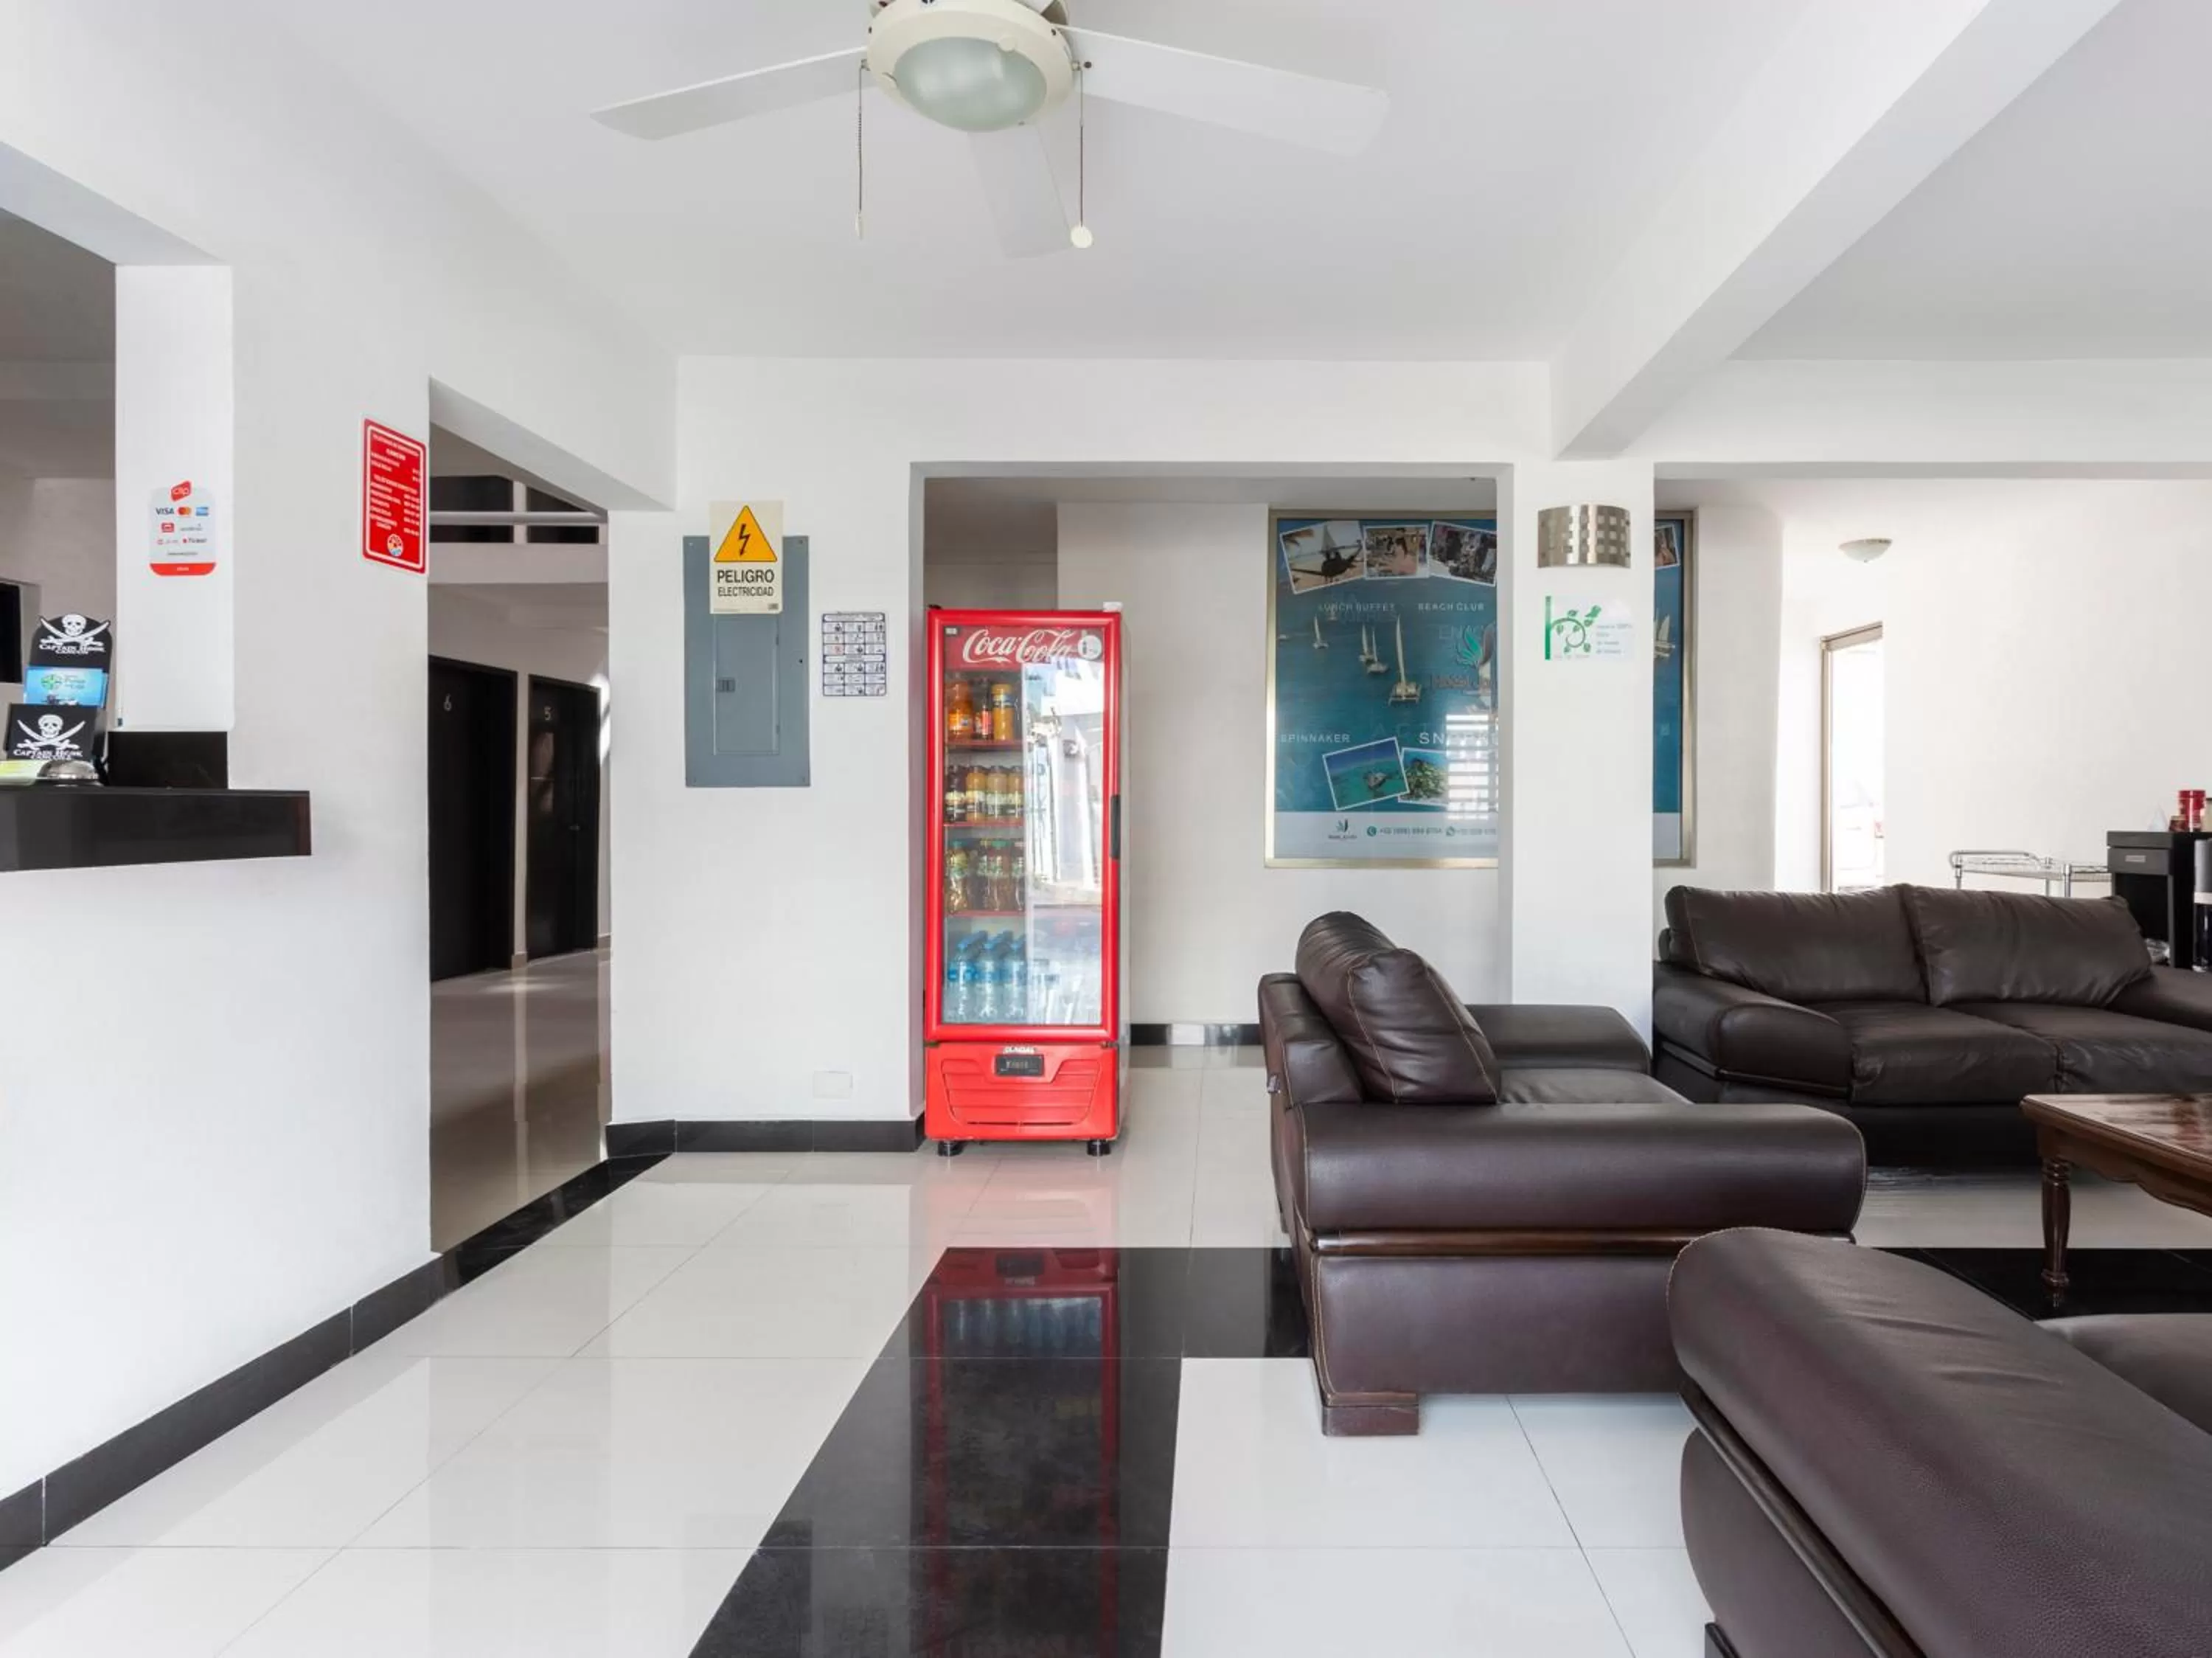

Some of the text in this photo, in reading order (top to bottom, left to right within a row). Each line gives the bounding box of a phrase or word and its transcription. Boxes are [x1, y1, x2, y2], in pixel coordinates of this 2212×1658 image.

[155, 507, 175, 516] VISA
[717, 569, 775, 583] PELIGRO
[717, 586, 774, 597] ELECTRICIDAD
[1356, 603, 1395, 611] BUFFET
[1418, 602, 1484, 612] BEACH CLUB
[444, 693, 452, 712] 6
[543, 706, 552, 721] 5
[1280, 734, 1351, 743] SPINNAKER
